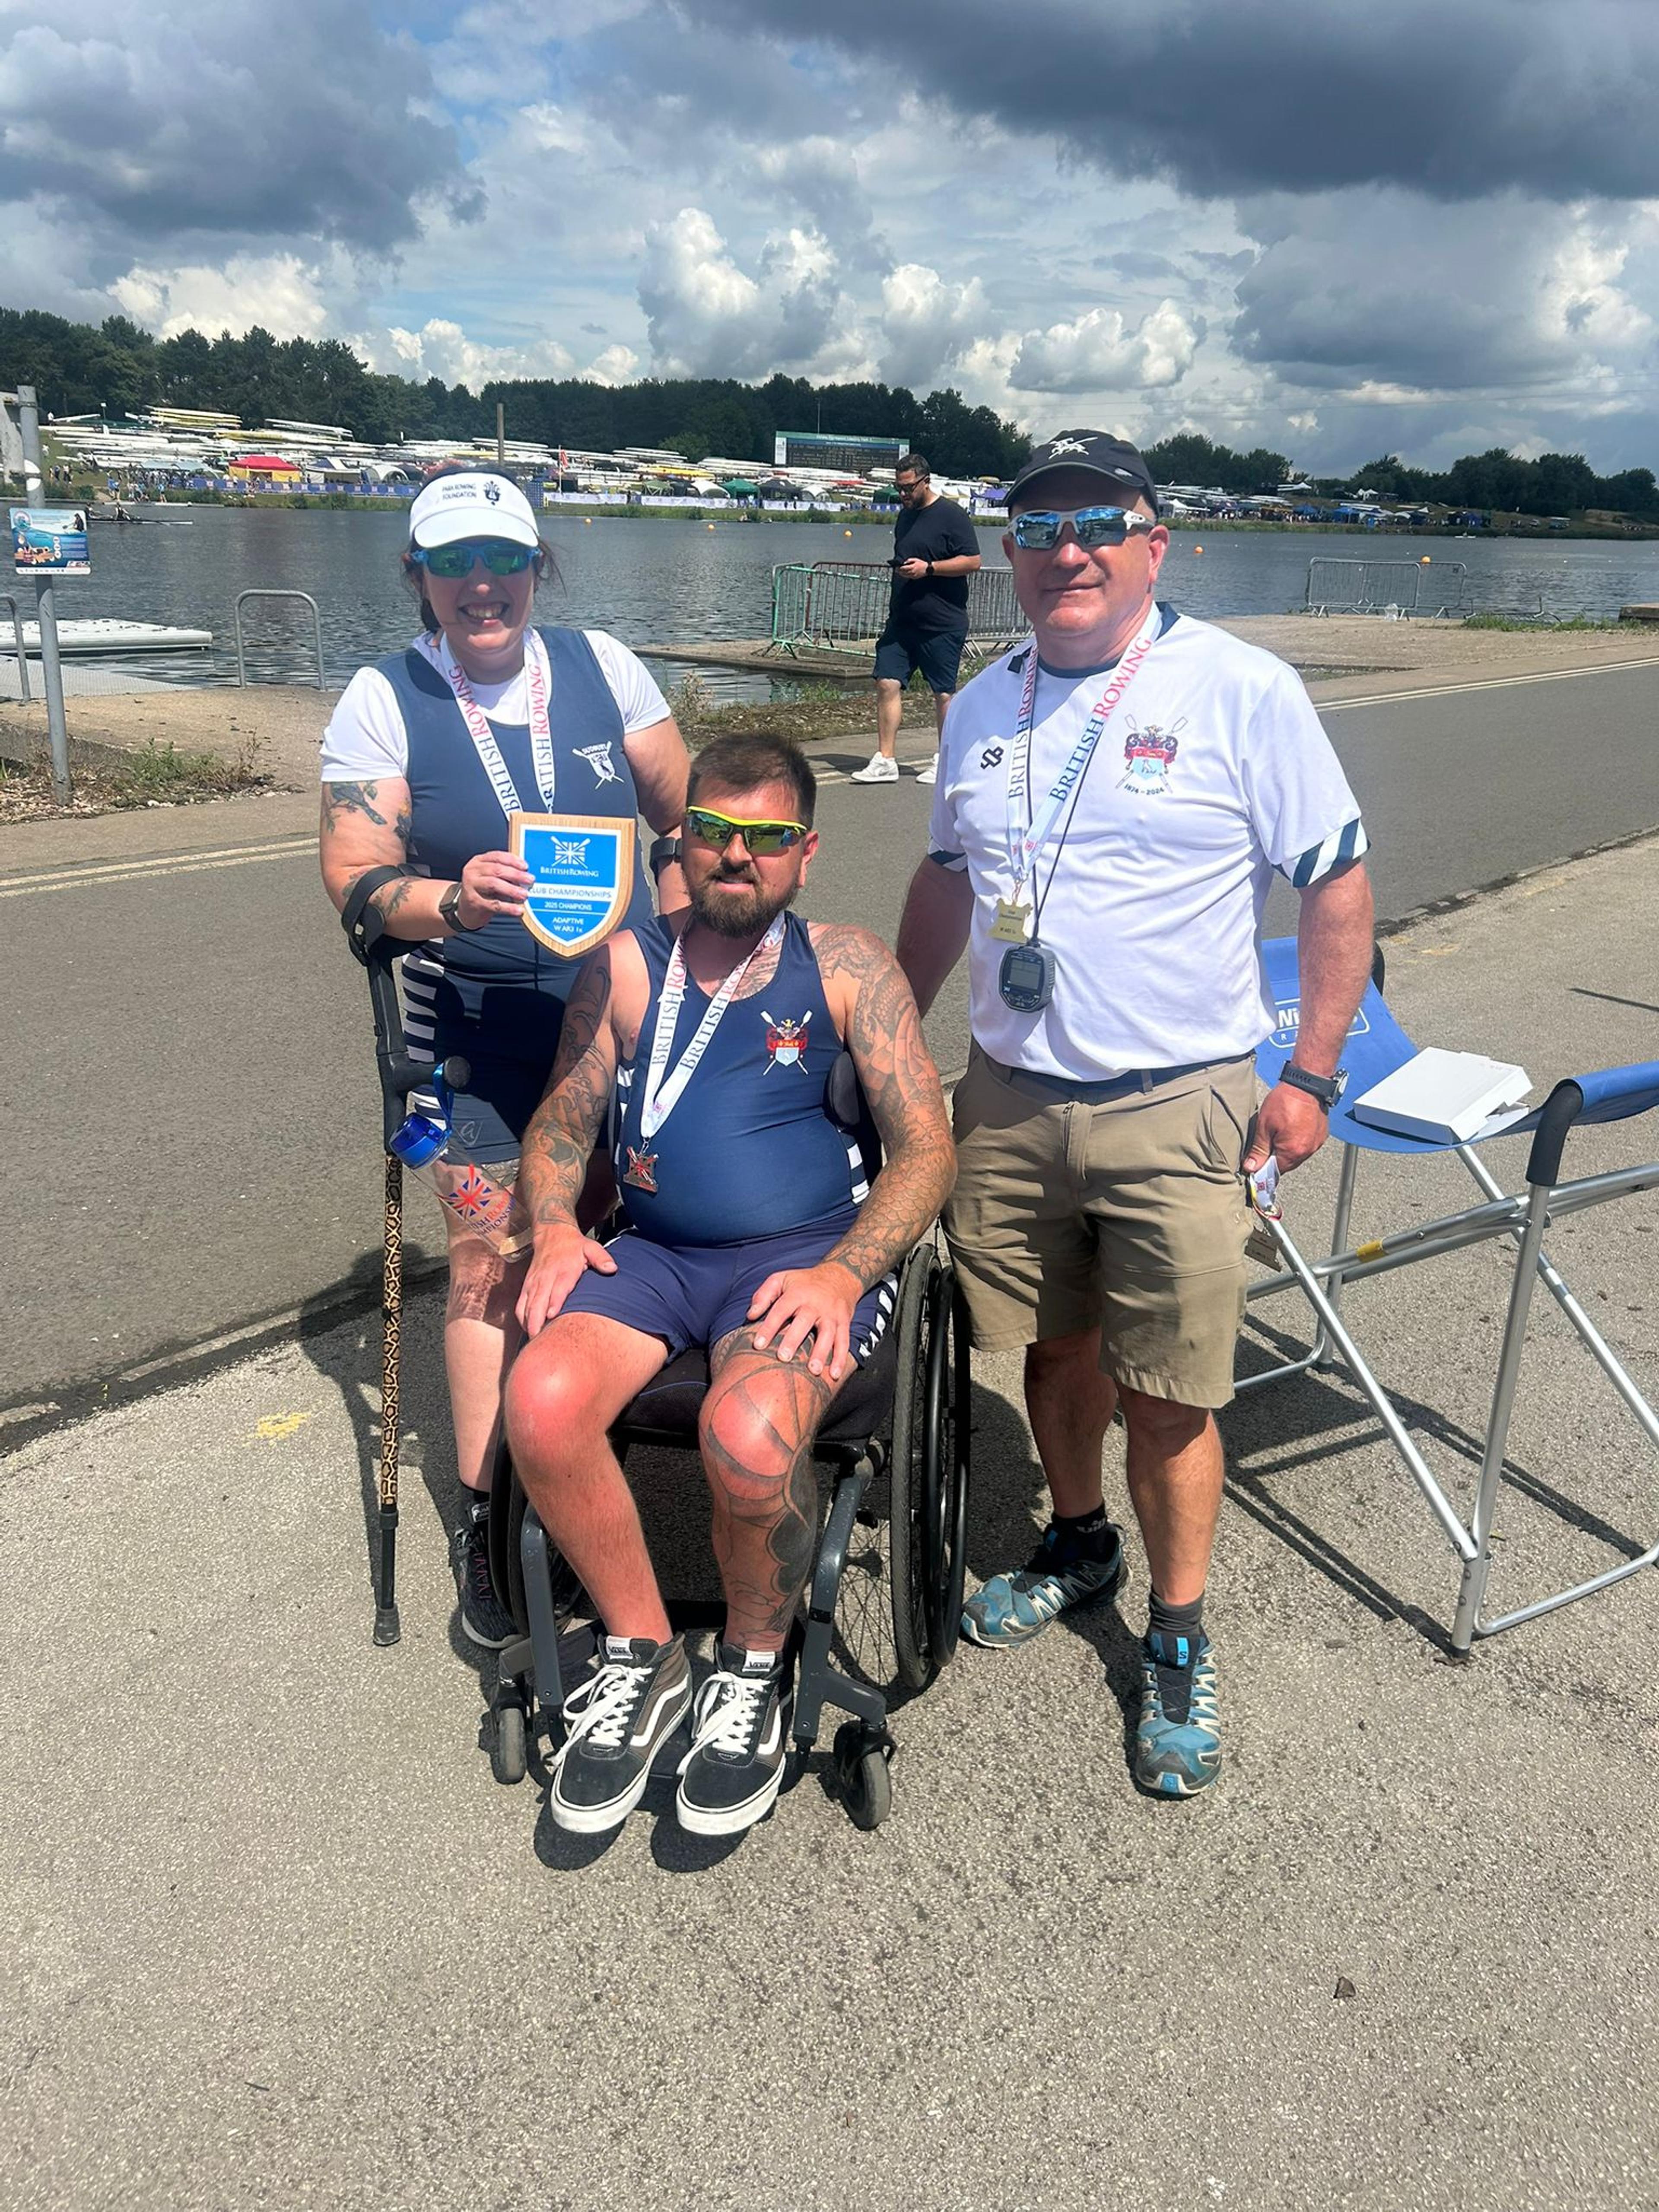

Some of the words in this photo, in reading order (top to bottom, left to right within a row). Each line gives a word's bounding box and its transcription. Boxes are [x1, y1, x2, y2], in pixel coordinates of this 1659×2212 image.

[442, 492, 477, 500] FOUNDATION
[548, 888, 611, 898] CHAMPIONSHIPS
[558, 902, 593, 911] CHAMPIONS
[552, 917, 584, 925] ADAPTIVE
